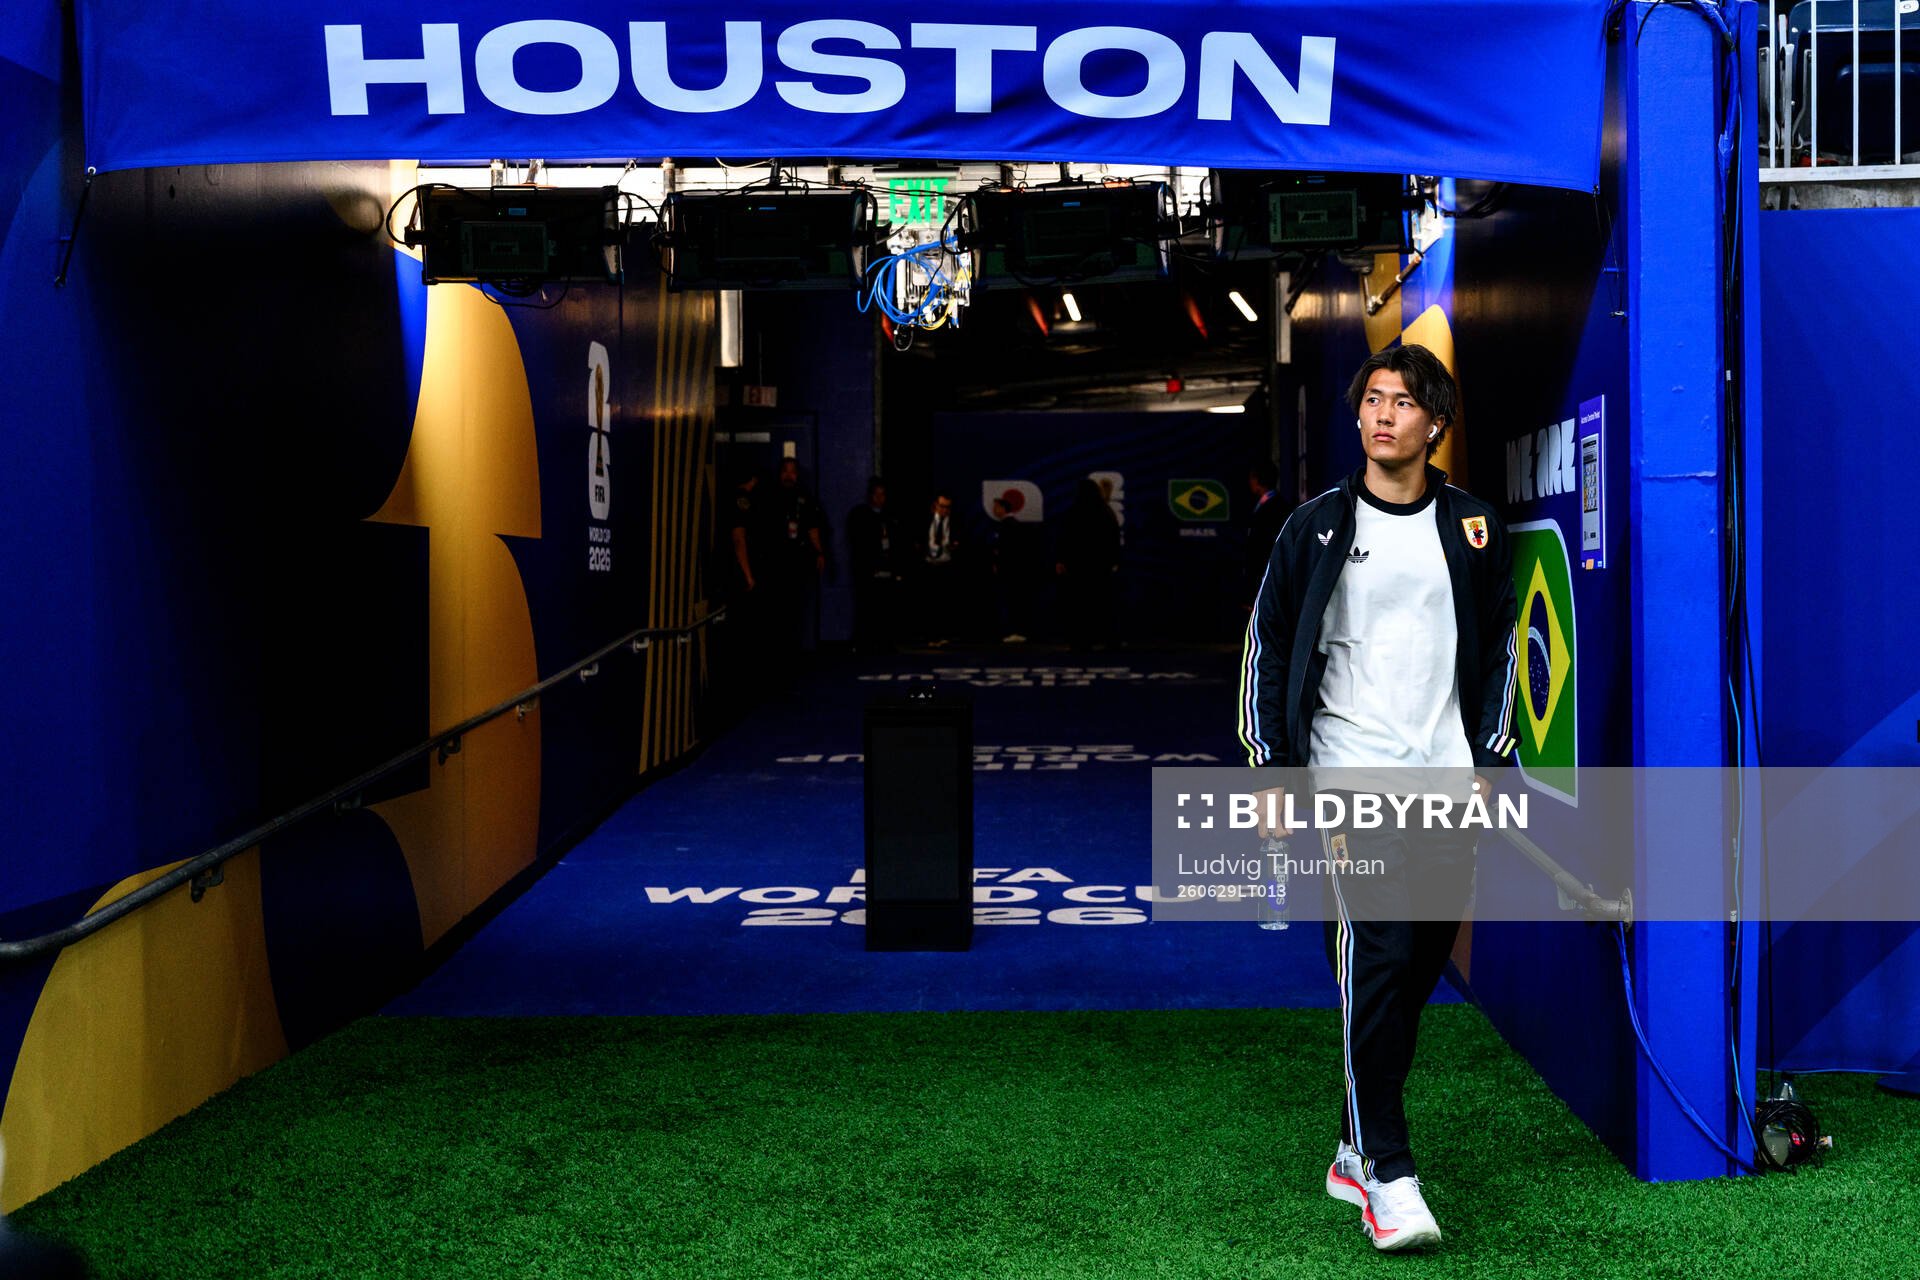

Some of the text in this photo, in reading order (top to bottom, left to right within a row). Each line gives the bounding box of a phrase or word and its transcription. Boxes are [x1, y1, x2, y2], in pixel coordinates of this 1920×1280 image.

[324, 18, 1336, 127] HOUSTON
[888, 177, 949, 223] EXIT
[588, 546, 611, 572] 2026
[774, 753, 866, 763] UP
[973, 762, 1079, 771] FIF
[740, 907, 1148, 926] 226
